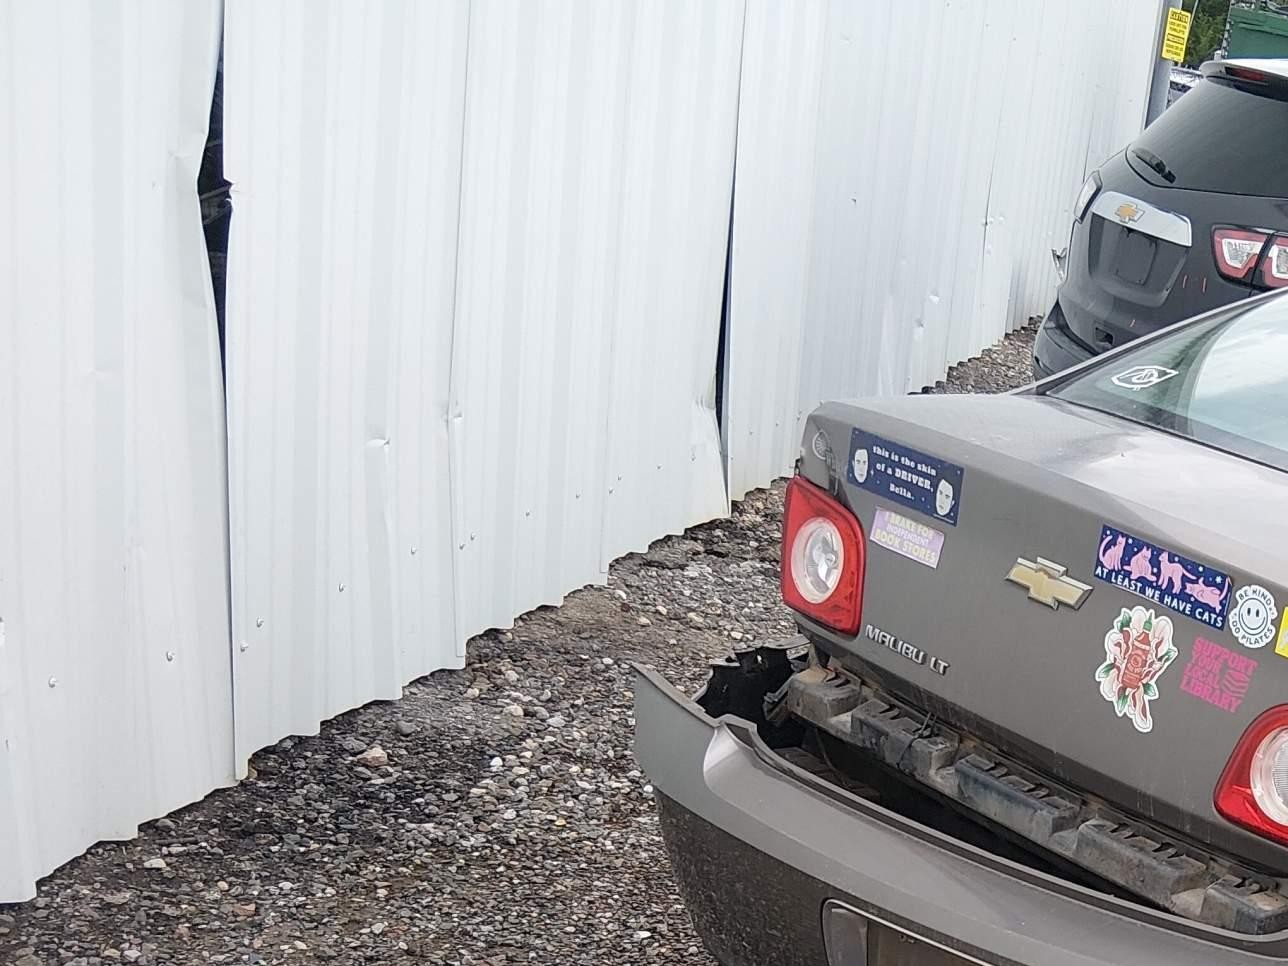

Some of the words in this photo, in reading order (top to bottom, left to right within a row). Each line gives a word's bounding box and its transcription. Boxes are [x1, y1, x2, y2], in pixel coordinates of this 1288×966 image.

[873, 445, 889, 458] this
[891, 451, 899, 462] is
[901, 456, 915, 468] the
[917, 463, 936, 476] skin
[876, 463, 885, 472] of
[875, 528, 900, 549] BOOK
[902, 540, 936, 563] STORES
[1095, 566, 1108, 579] AT
[1111, 572, 1142, 592] LEAST
[1145, 587, 1160, 601] WE
[1163, 594, 1193, 615] HAVE
[1195, 608, 1223, 627] CATS
[1238, 589, 1249, 600] BE
[1252, 588, 1272, 606] KIND
[1232, 620, 1240, 634] DO
[1241, 626, 1273, 645] PILATES
[865, 624, 925, 665] MALIBU
[930, 656, 949, 675] LT
[1191, 654, 1220, 674] YOUR
[1192, 637, 1258, 677] SUPPORT
[1184, 663, 1221, 689] LOCAL
[1180, 675, 1243, 713] LIBRARY
